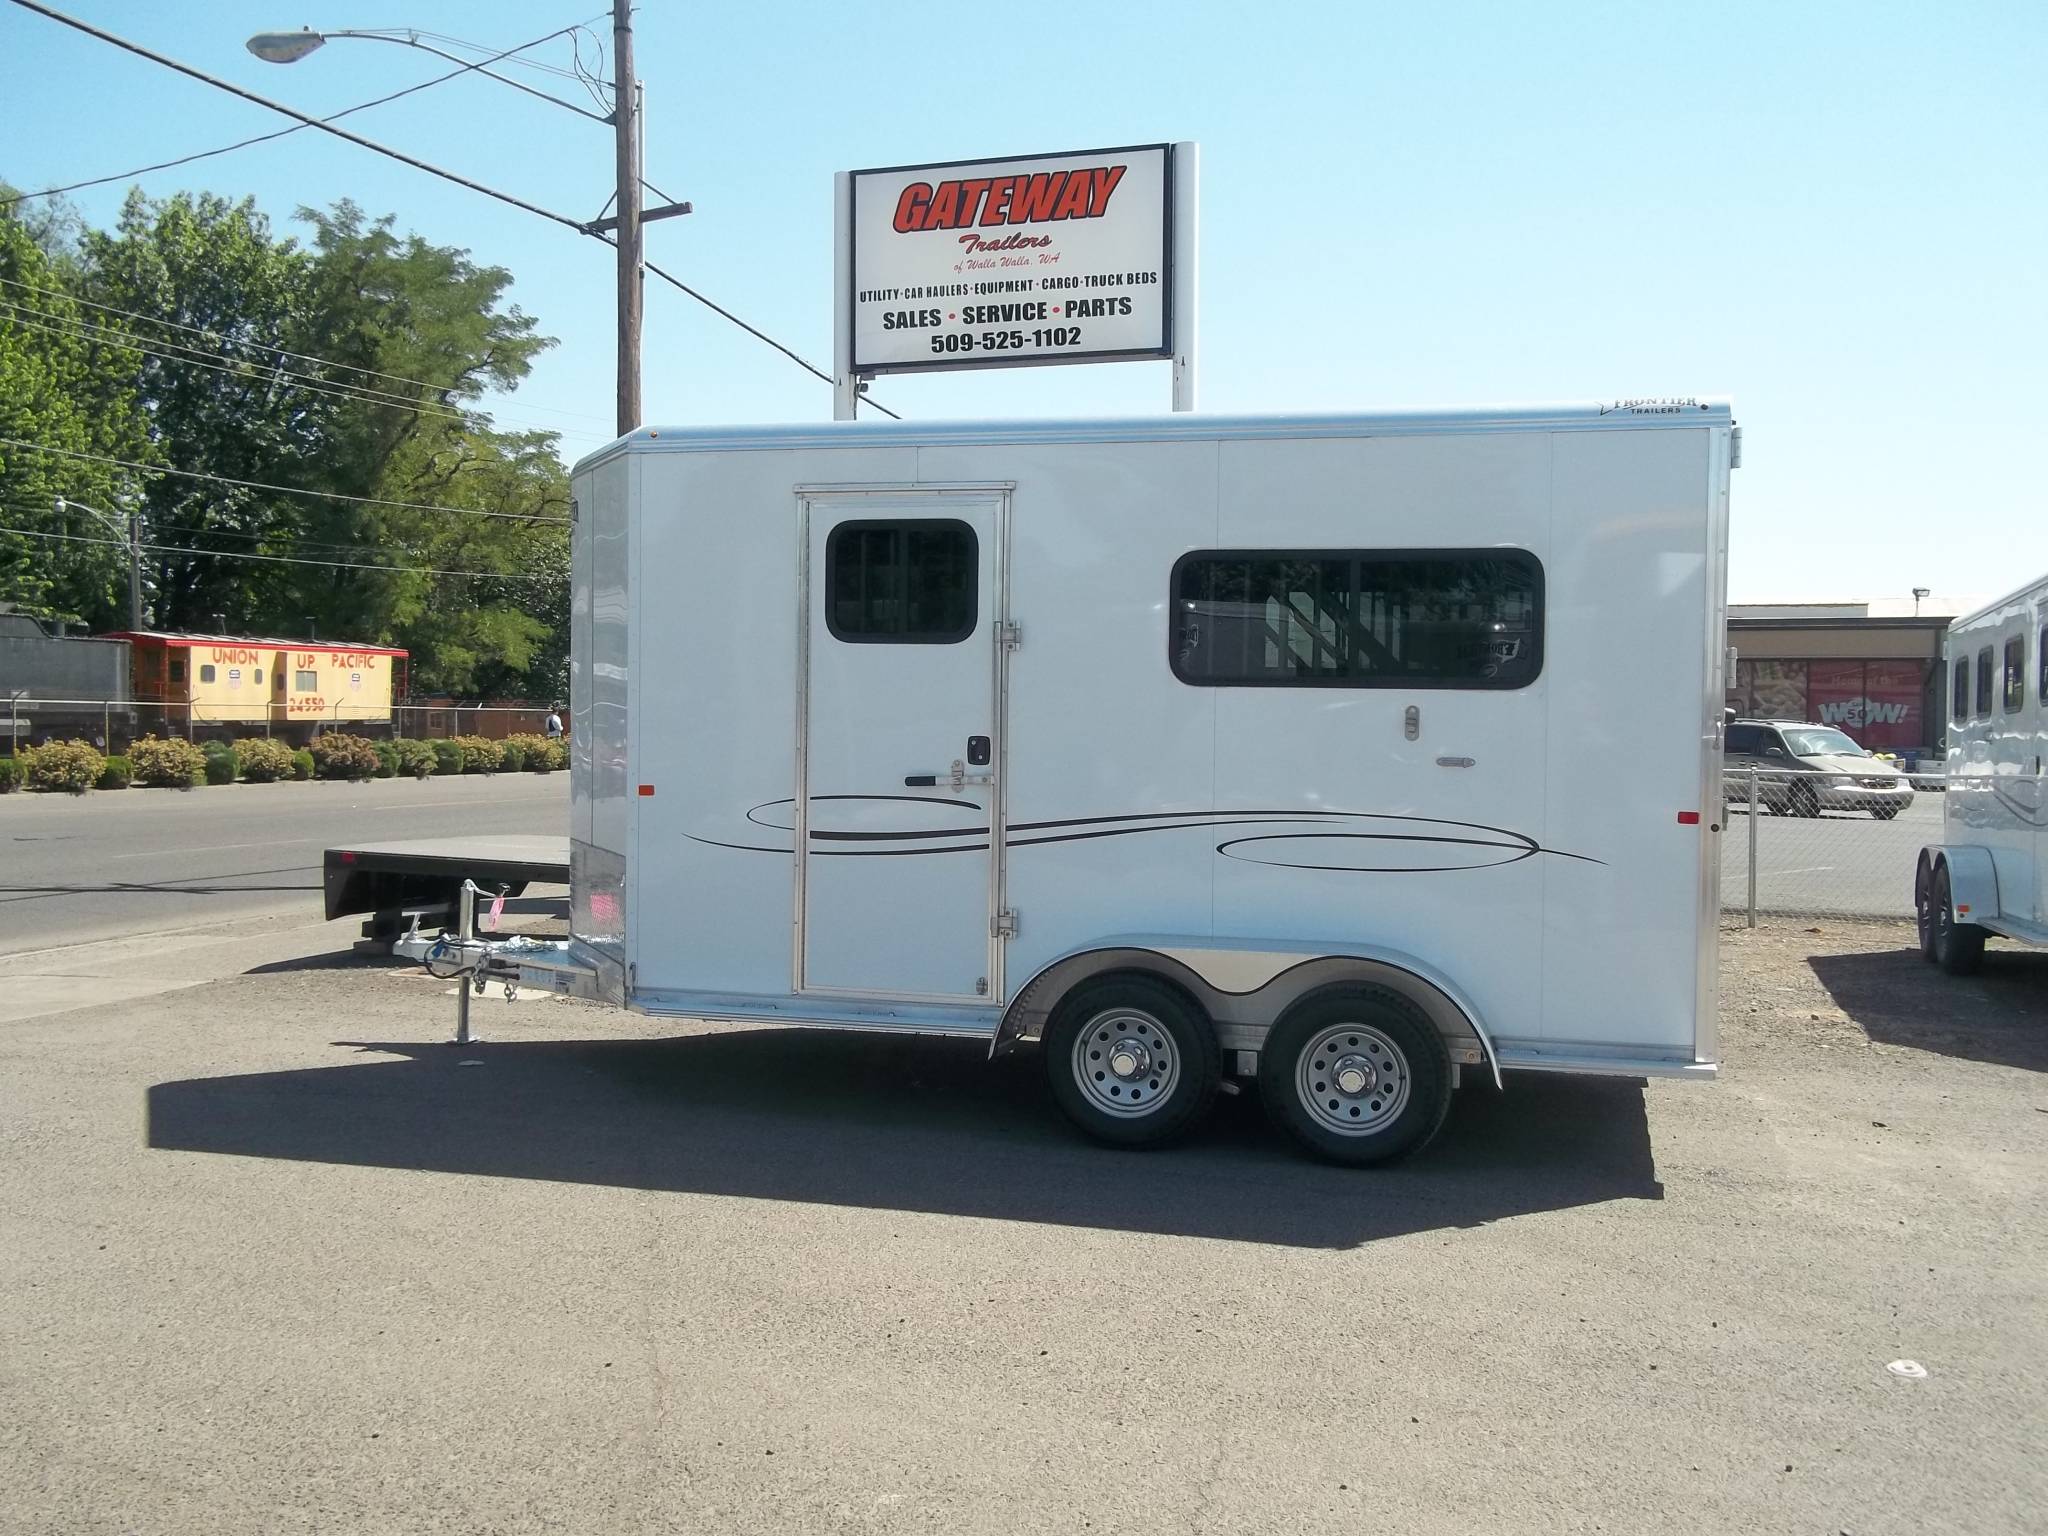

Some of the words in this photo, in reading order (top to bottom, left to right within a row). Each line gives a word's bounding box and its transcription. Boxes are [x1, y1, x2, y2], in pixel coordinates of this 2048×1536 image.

[892, 165, 1127, 234] GATEWAY
[958, 231, 1053, 255] Trailers
[953, 259, 964, 274] of
[966, 258, 996, 271] Walla
[1038, 251, 1061, 265] WA
[859, 288, 900, 303] UTILITY
[904, 287, 923, 300] CAR
[926, 283, 969, 298] HAULERS
[974, 279, 1034, 296] EQUIPMENT
[1041, 276, 1079, 291] CARGO
[1084, 273, 1124, 288] TRUCK
[1126, 271, 1158, 286] BEDS
[882, 308, 942, 331] SALES
[962, 301, 1048, 325] SERVICE
[1065, 296, 1132, 319] PARTS
[930, 326, 1082, 354] 509-525-1102
[1631, 407, 1681, 415] TRAILERS
[212, 647, 259, 665] UNION
[297, 653, 316, 670] UP
[331, 653, 376, 670] PACIFIC
